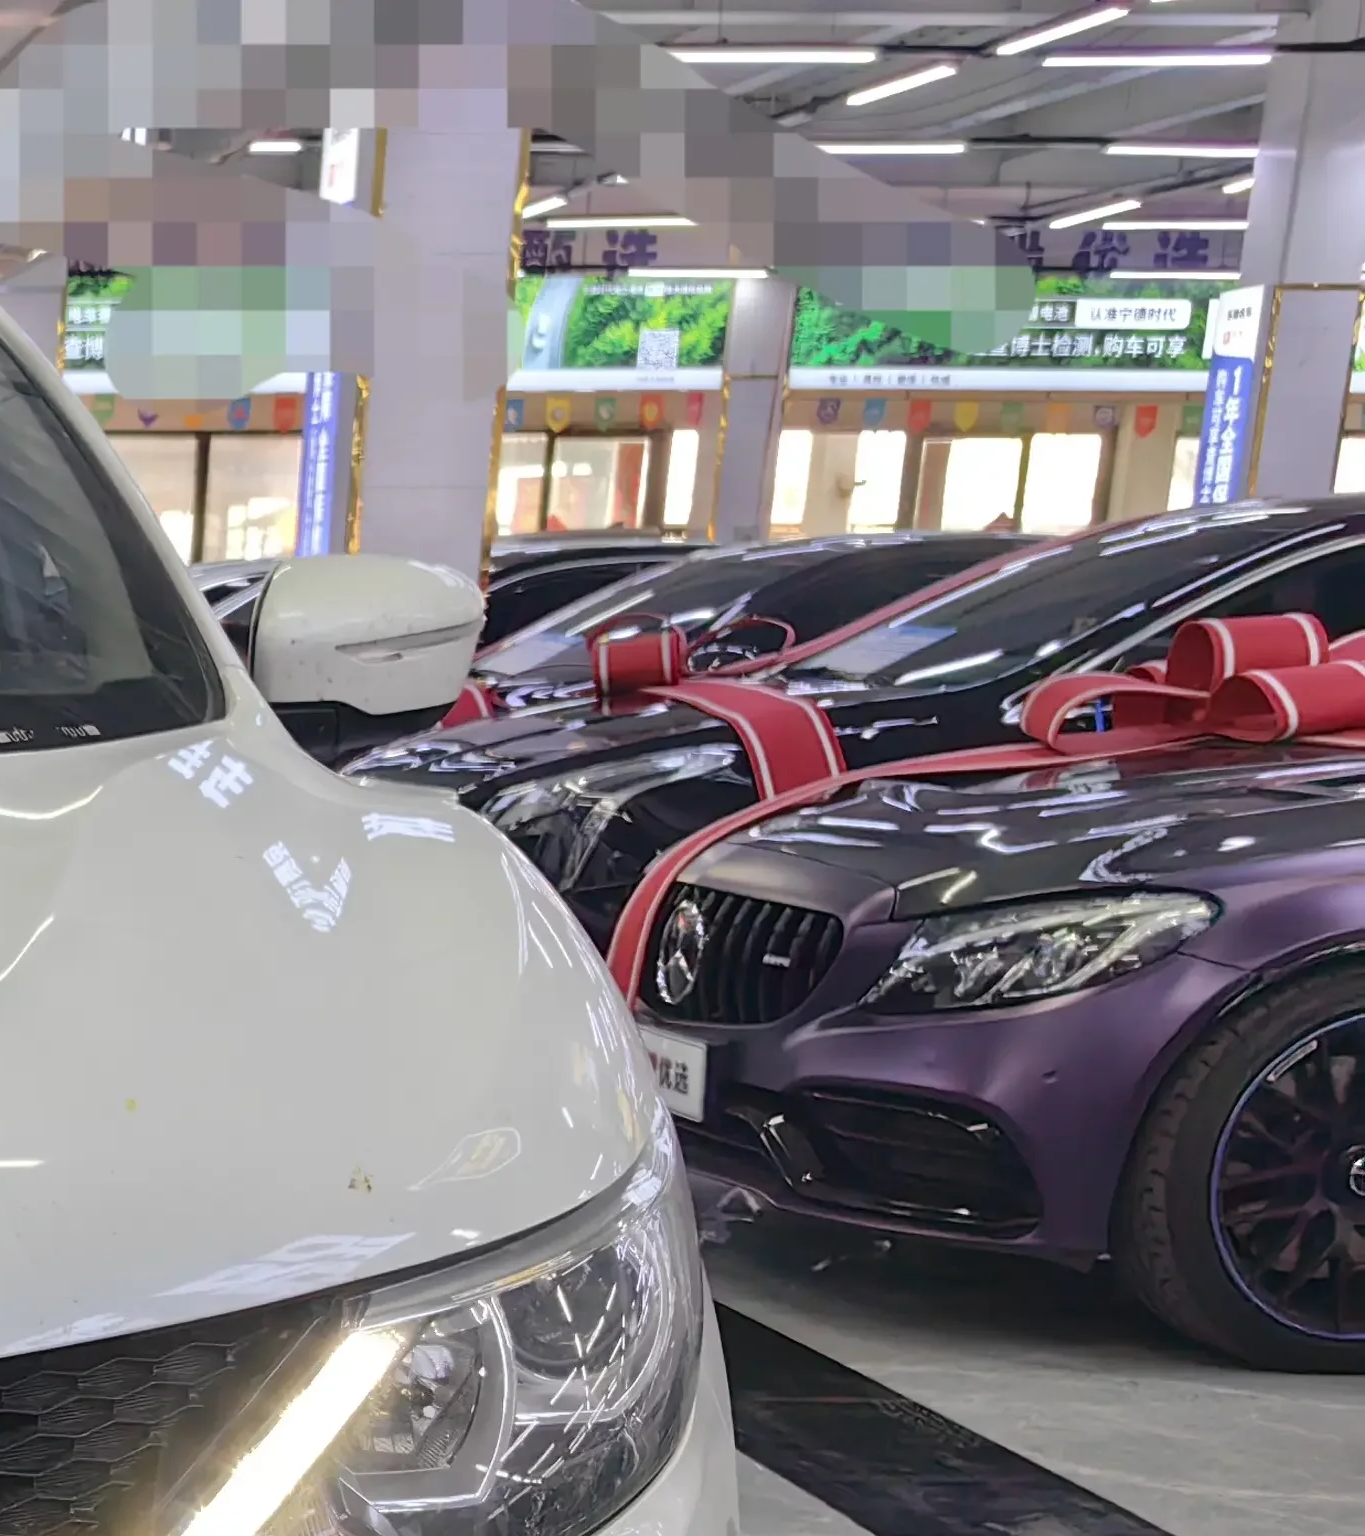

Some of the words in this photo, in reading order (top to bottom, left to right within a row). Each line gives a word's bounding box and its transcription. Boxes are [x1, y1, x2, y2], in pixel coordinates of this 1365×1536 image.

[993, 332, 1188, 359] 博士检测，购车可享
